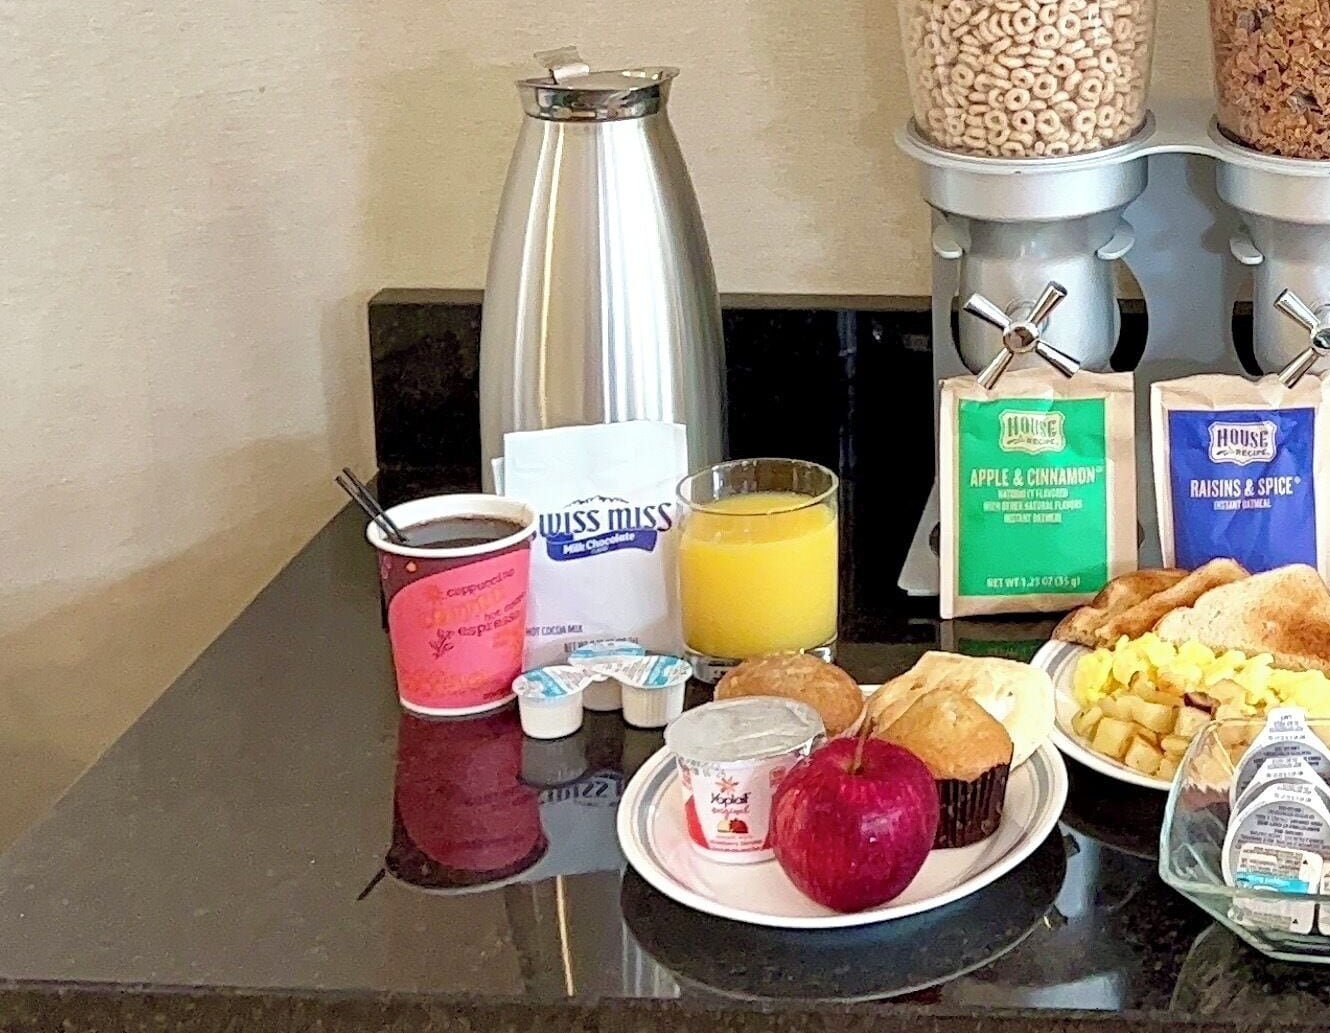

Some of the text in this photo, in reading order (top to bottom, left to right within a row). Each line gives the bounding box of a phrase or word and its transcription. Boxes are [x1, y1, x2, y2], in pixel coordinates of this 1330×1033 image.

[1007, 416, 1057, 438] HOUSE
[1217, 428, 1268, 448] HOUSE
[1235, 448, 1266, 457] RECIPE
[970, 466, 1096, 487] APPLE & CINNAMON
[1190, 476, 1293, 498] RAISINS & SPICE
[539, 502, 672, 538] WISS MISS
[562, 543, 585, 555] Milk
[585, 531, 636, 550] Chocolate
[711, 792, 750, 808] Yoplait
